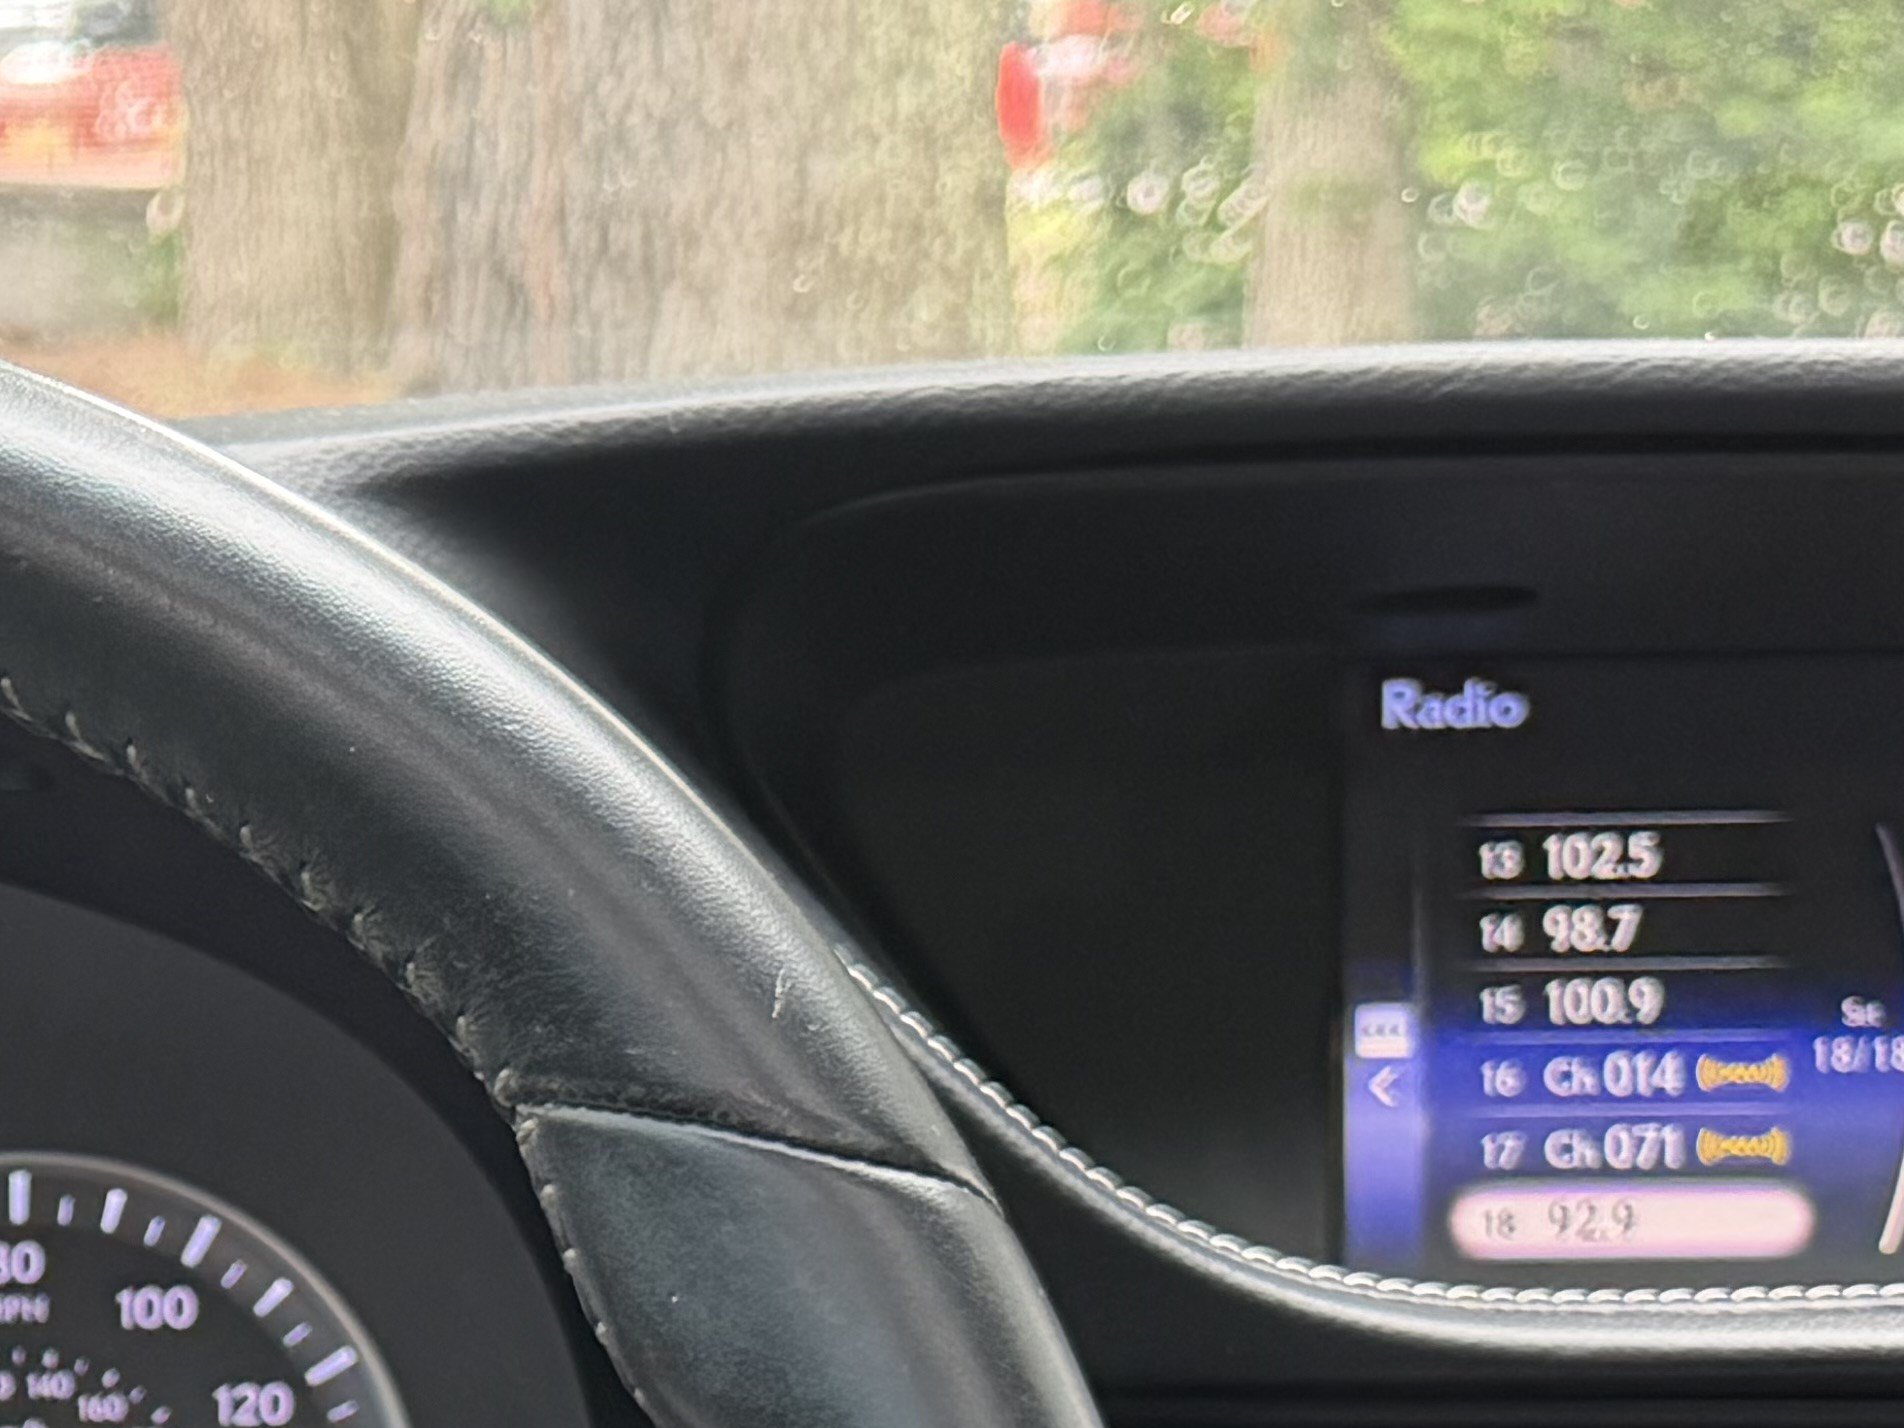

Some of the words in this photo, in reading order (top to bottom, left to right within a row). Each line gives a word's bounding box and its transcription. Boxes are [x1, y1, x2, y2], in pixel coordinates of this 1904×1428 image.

[1381, 677, 1528, 730] Radio
[1479, 838, 1523, 879] 13
[1542, 831, 1663, 880] 102.5
[1479, 912, 1523, 952] 14
[1542, 903, 1643, 953] 98.7
[1479, 984, 1524, 1026] 15
[1544, 976, 1665, 1026] 100.9
[1481, 1061, 1524, 1097] 16
[1542, 1055, 1597, 1096] Ch
[1602, 1051, 1686, 1096] 014
[1481, 1130, 1527, 1170] 17
[1542, 1128, 1597, 1170] Ch
[1603, 1123, 1686, 1170] 071
[1482, 1207, 1517, 1240] 18
[1546, 1197, 1639, 1243] 92.9
[115, 1284, 199, 1331] 100
[26, 1369, 76, 1400] 140
[212, 1383, 294, 1428] 120
[78, 1393, 129, 1424] 160
